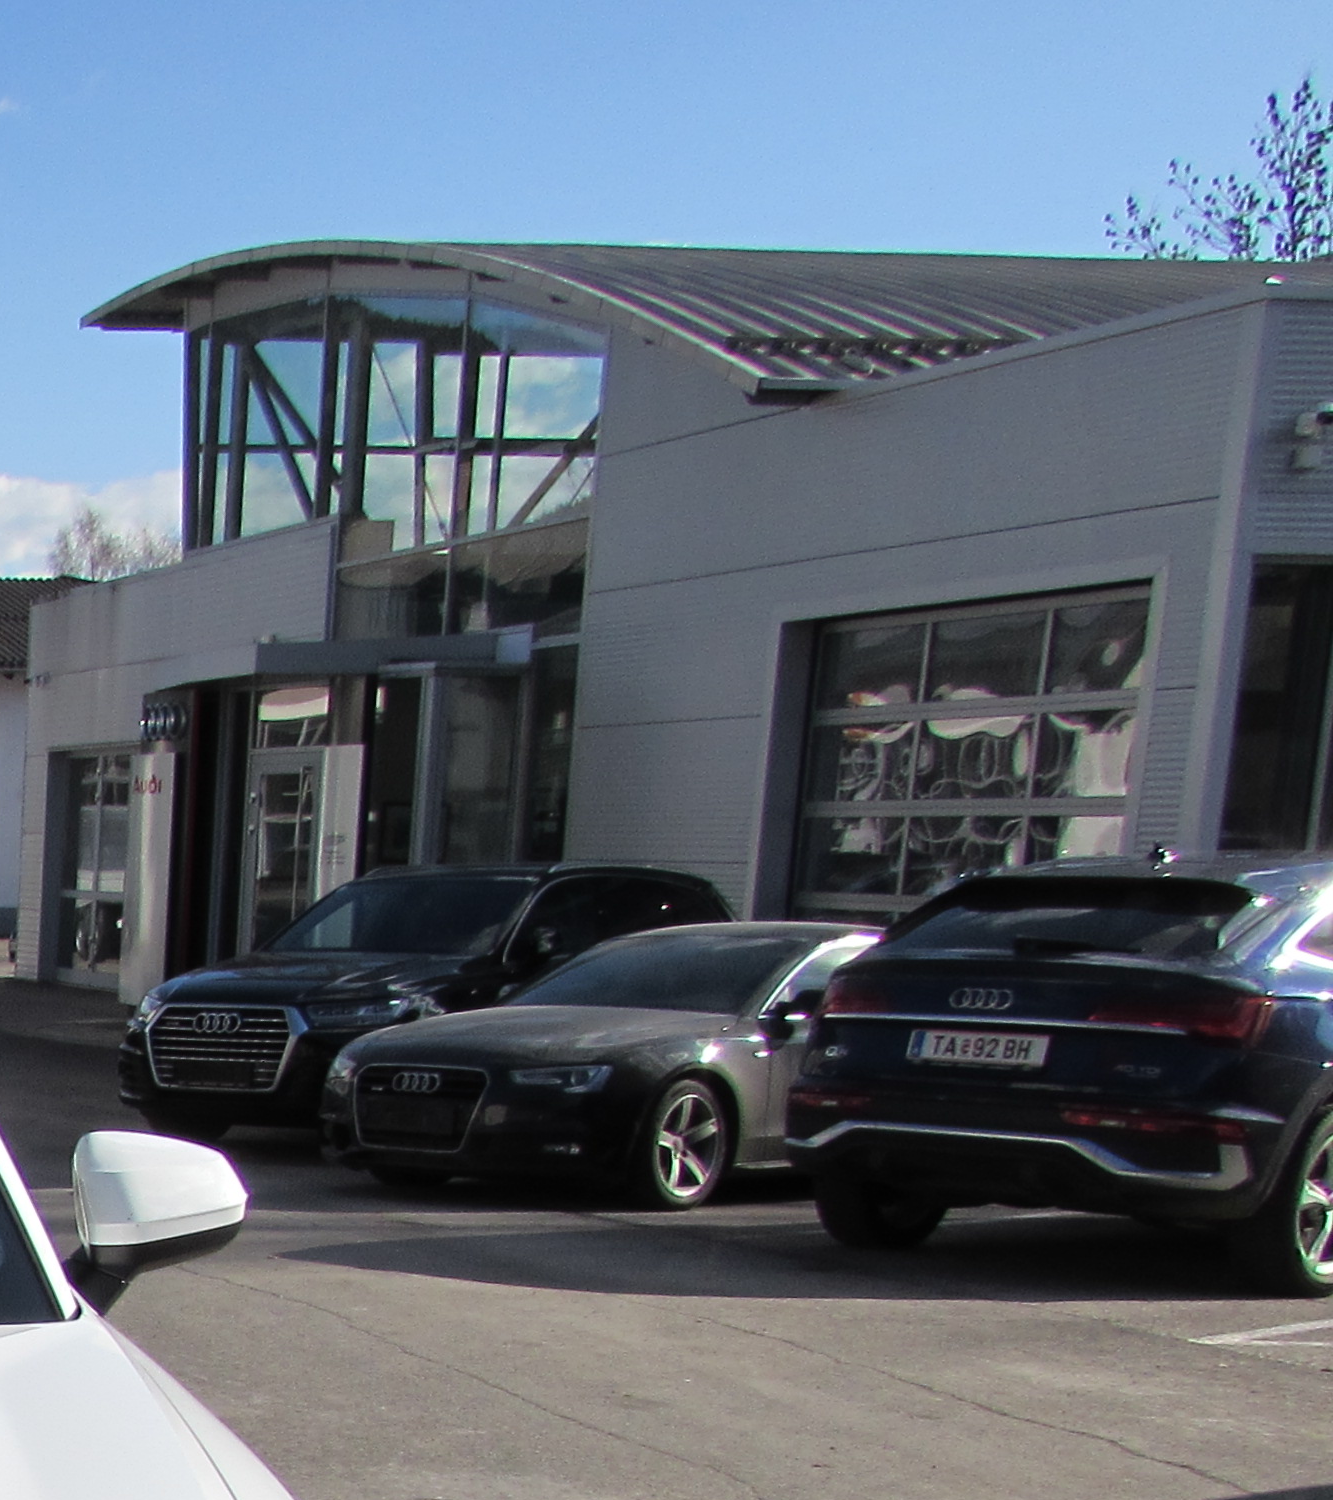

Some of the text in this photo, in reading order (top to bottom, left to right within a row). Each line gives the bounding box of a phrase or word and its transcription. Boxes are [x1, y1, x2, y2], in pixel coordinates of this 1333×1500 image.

[133, 774, 163, 795] Audi
[932, 1034, 1031, 1060] TA 92 BH
